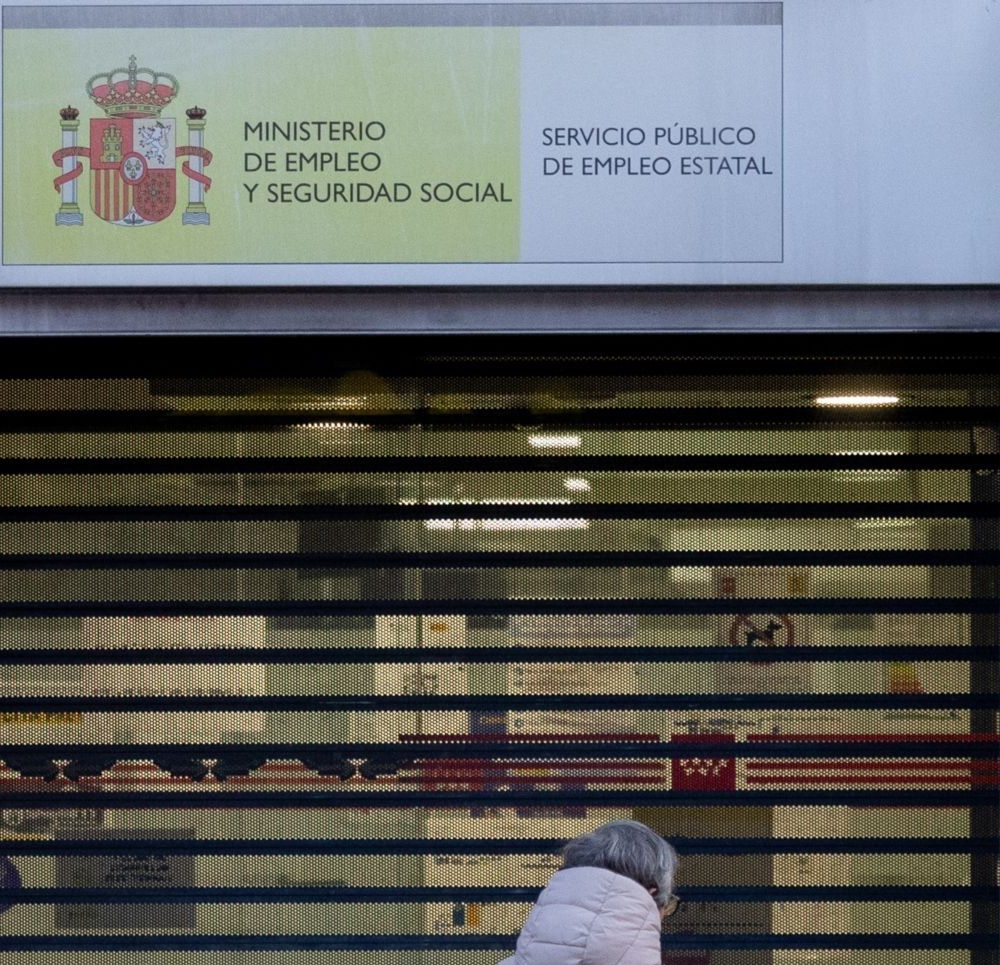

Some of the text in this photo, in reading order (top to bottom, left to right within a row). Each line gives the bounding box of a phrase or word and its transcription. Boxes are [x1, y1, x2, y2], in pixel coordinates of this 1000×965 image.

[243, 121, 386, 142] MINISTERIO
[541, 122, 756, 147] SERVICIO PÚBLICO
[243, 152, 382, 172] DE EMPLEO
[542, 156, 774, 176] DE EMPLEO ESTATAL
[242, 182, 513, 203] Y SEGURIDAD SOCIAL
